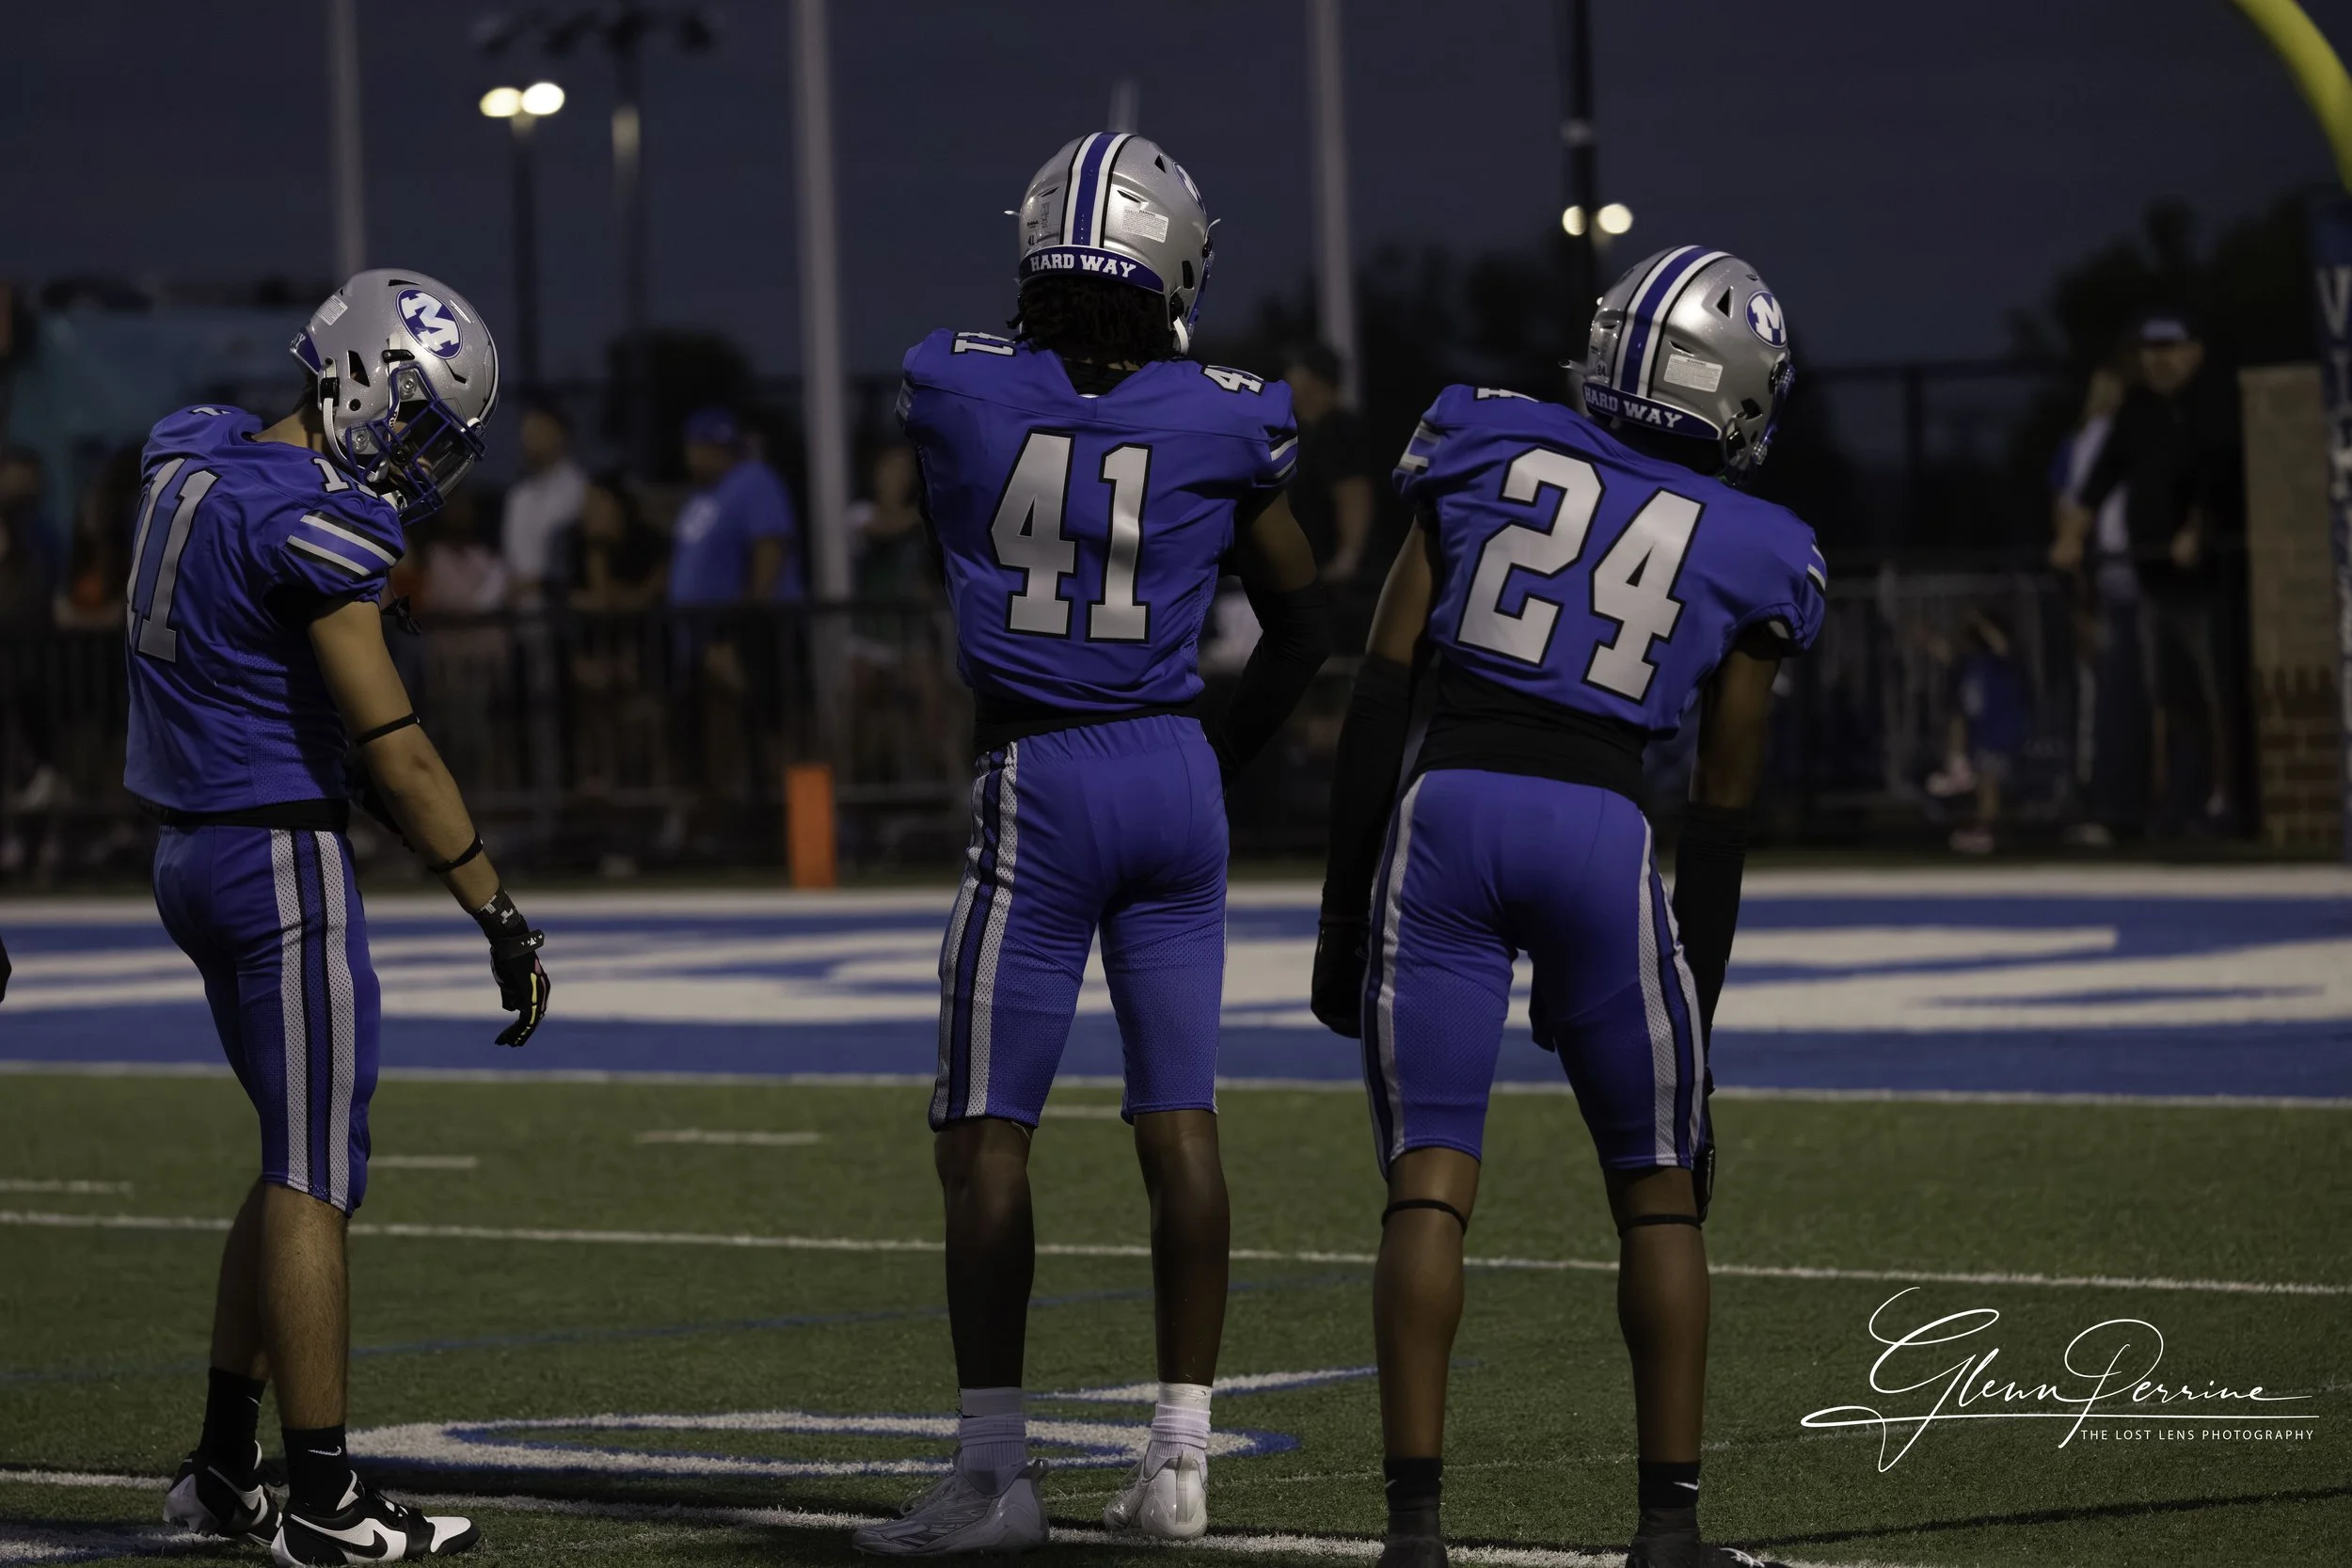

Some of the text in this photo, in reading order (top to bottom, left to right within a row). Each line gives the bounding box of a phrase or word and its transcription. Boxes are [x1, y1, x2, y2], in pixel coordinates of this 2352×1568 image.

[1030, 253, 1136, 278] HARD WAY
[1583, 385, 1684, 428] HARD WAY
[991, 433, 1149, 640] 41
[1457, 447, 1703, 702] 24
